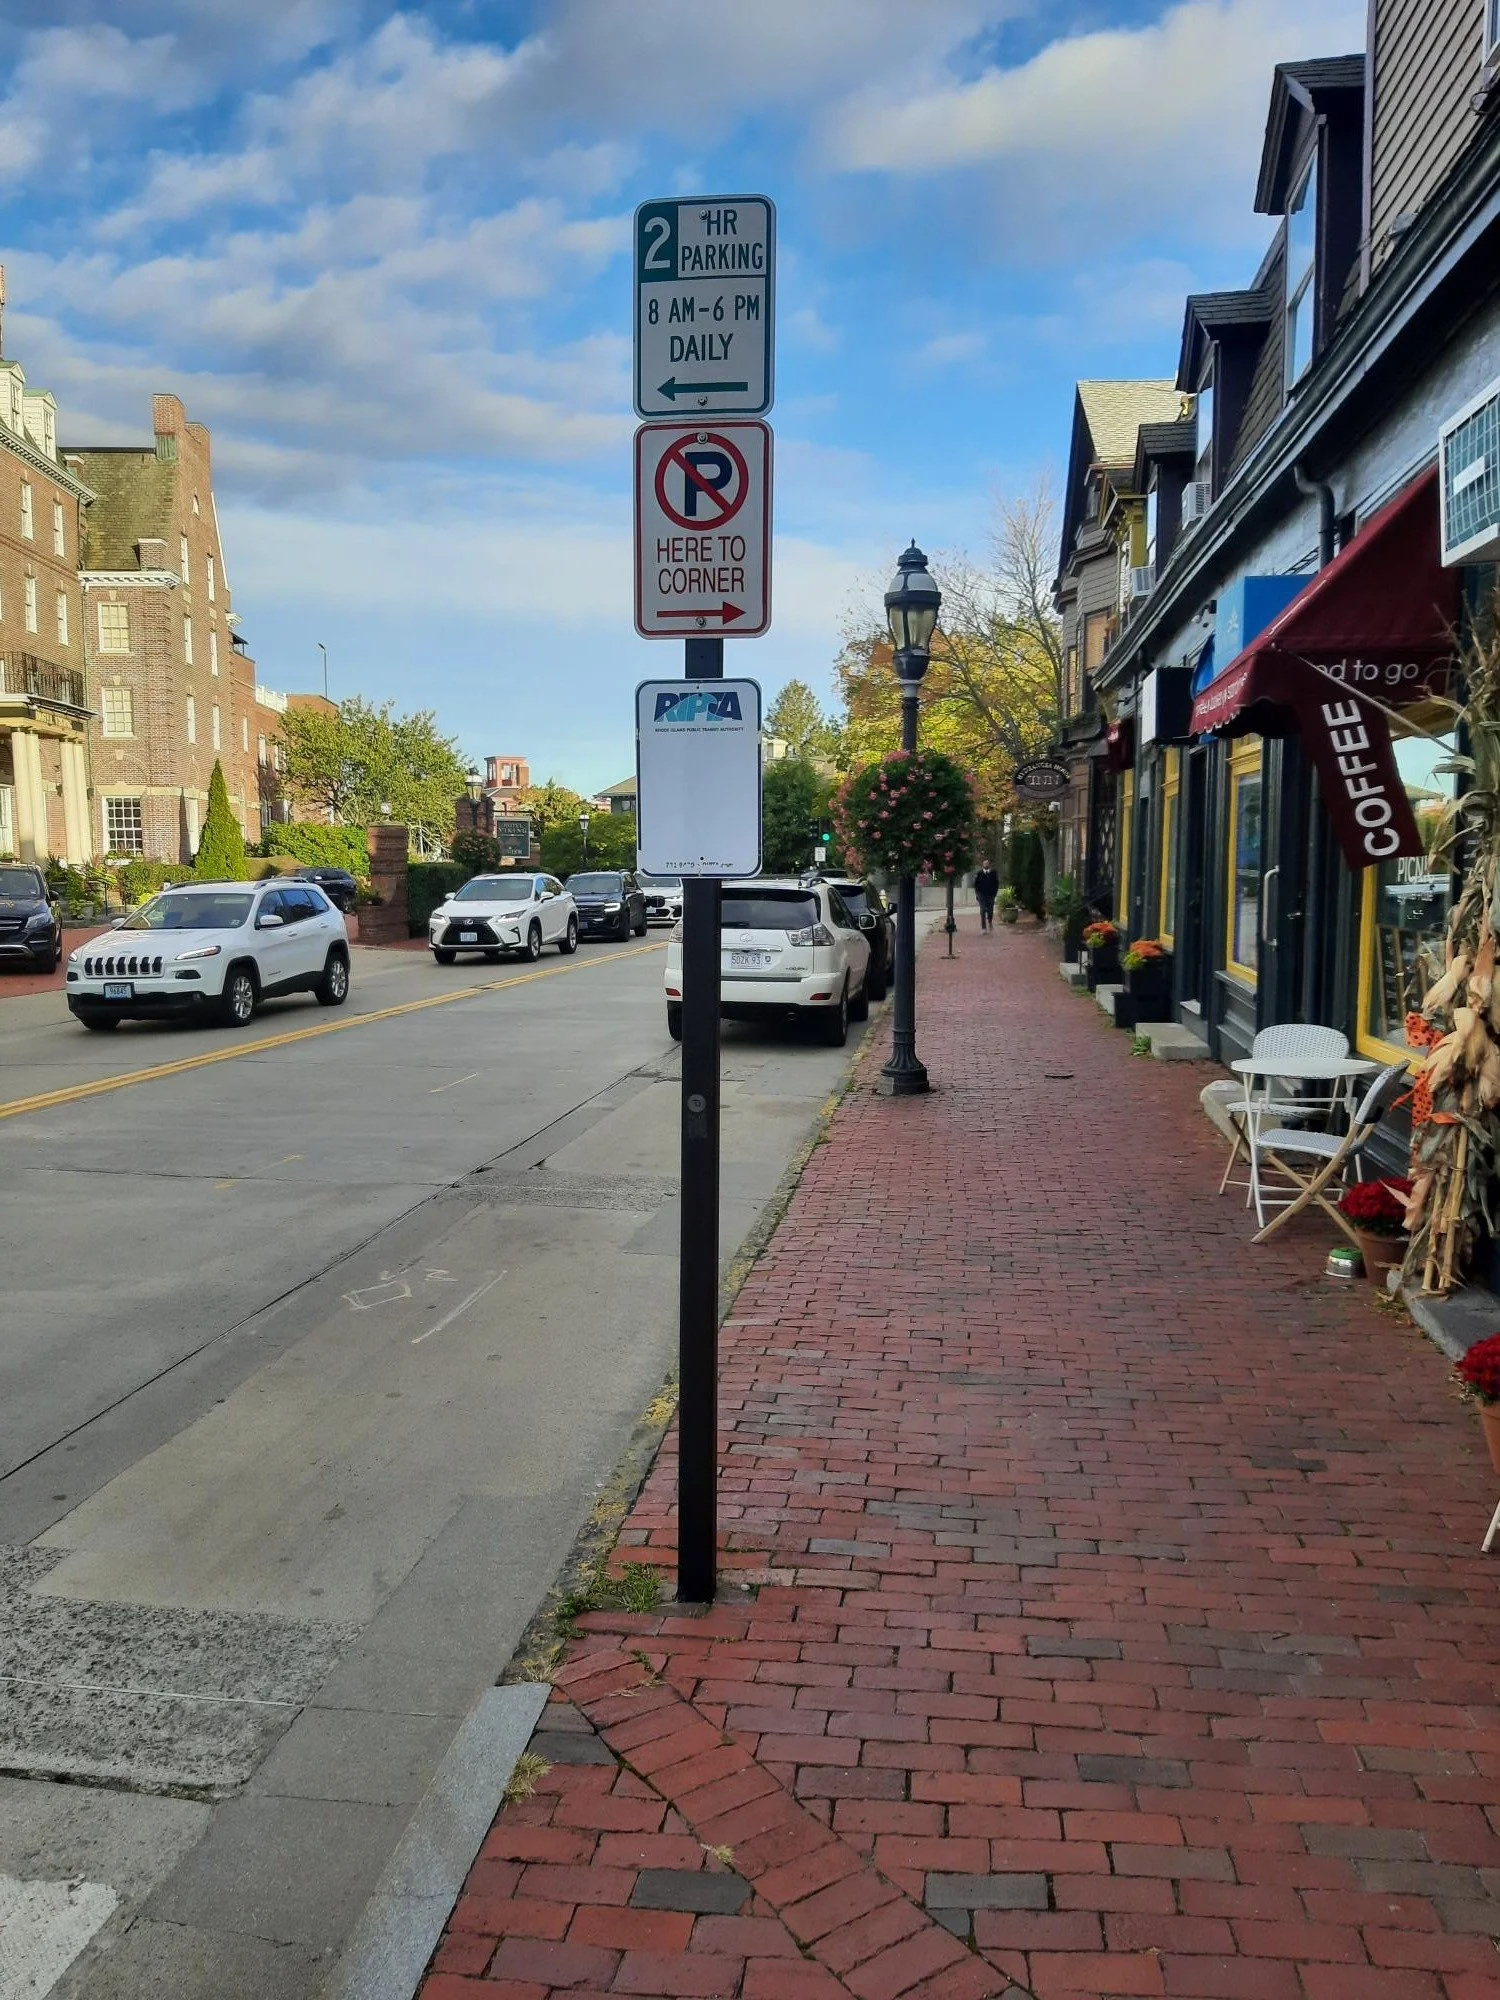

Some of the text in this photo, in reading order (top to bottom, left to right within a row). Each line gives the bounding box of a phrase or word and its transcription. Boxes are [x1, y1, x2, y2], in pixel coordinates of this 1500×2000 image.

[644, 209, 738, 270] 2 HR
[681, 242, 763, 272] PARKING
[648, 299, 659, 325] 8
[734, 295, 760, 321] PM
[670, 333, 734, 363] DAILY
[656, 536, 746, 563] HERE TO
[658, 568, 745, 594] CORNER
[1353, 659, 1378, 681] to
[1385, 663, 1419, 685] go
[653, 692, 742, 722] RIPTA
[1321, 700, 1400, 856] COFFEE
